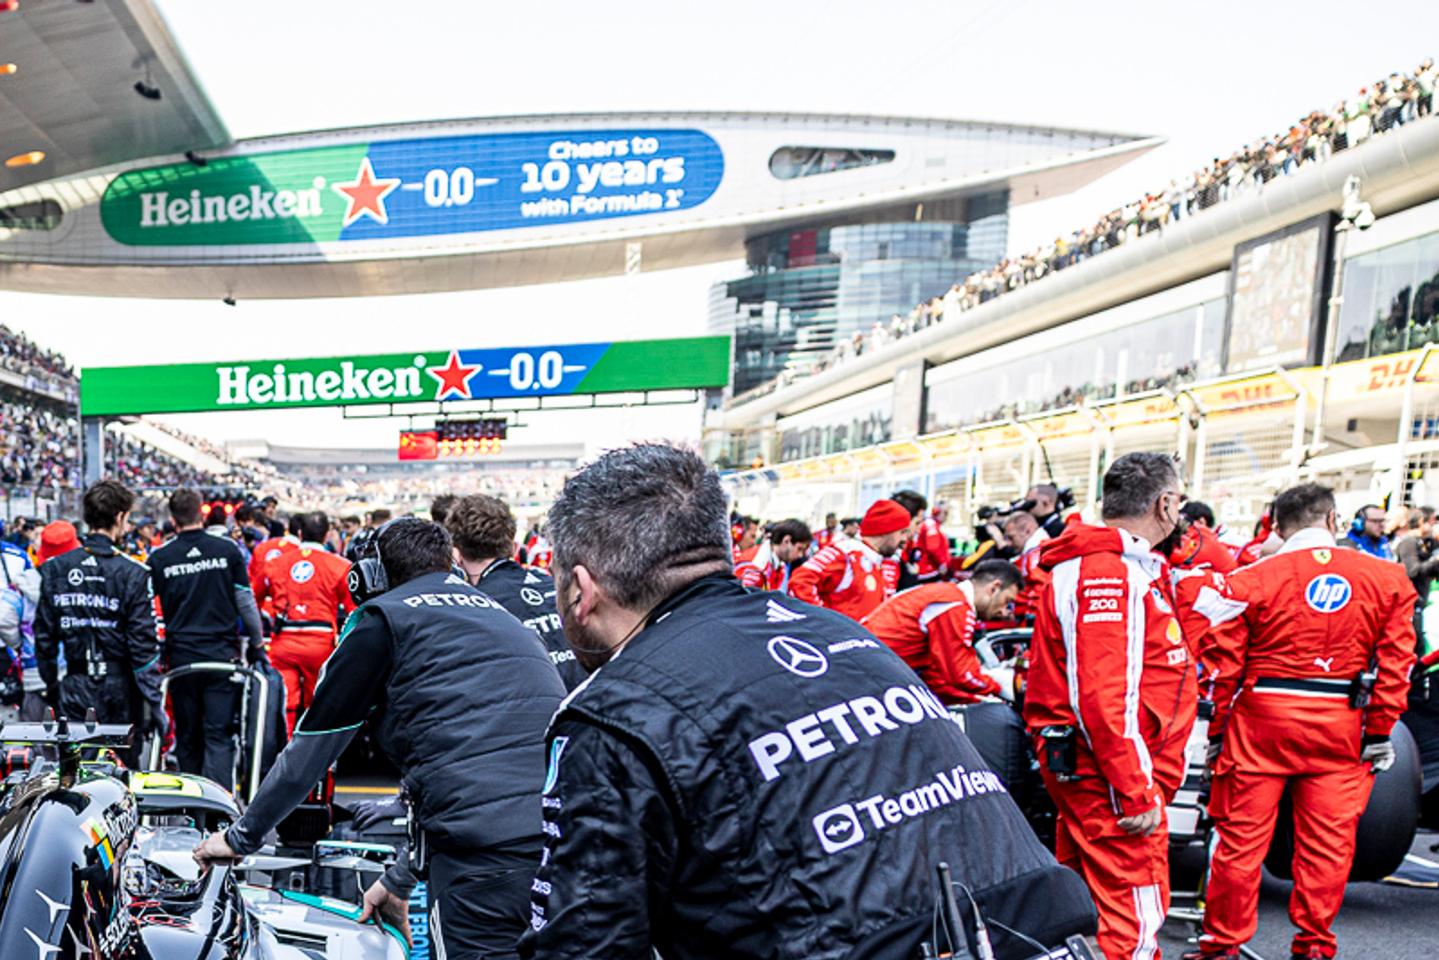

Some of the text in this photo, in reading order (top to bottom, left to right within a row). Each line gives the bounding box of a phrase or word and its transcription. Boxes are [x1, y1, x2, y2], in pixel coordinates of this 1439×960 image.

[547, 135, 659, 161] Cheers to
[520, 156, 686, 194] 10 years
[140, 184, 324, 228] Heineken
[520, 197, 570, 219] with
[570, 190, 664, 216] Formula
[215, 364, 425, 405] Heineken
[1368, 359, 1416, 391] DH
[163, 557, 228, 579] PETRONAS
[402, 592, 509, 613] PETRON
[1313, 573, 1348, 612] hp
[748, 684, 951, 782] PETRON
[856, 765, 1007, 830] TeamView
